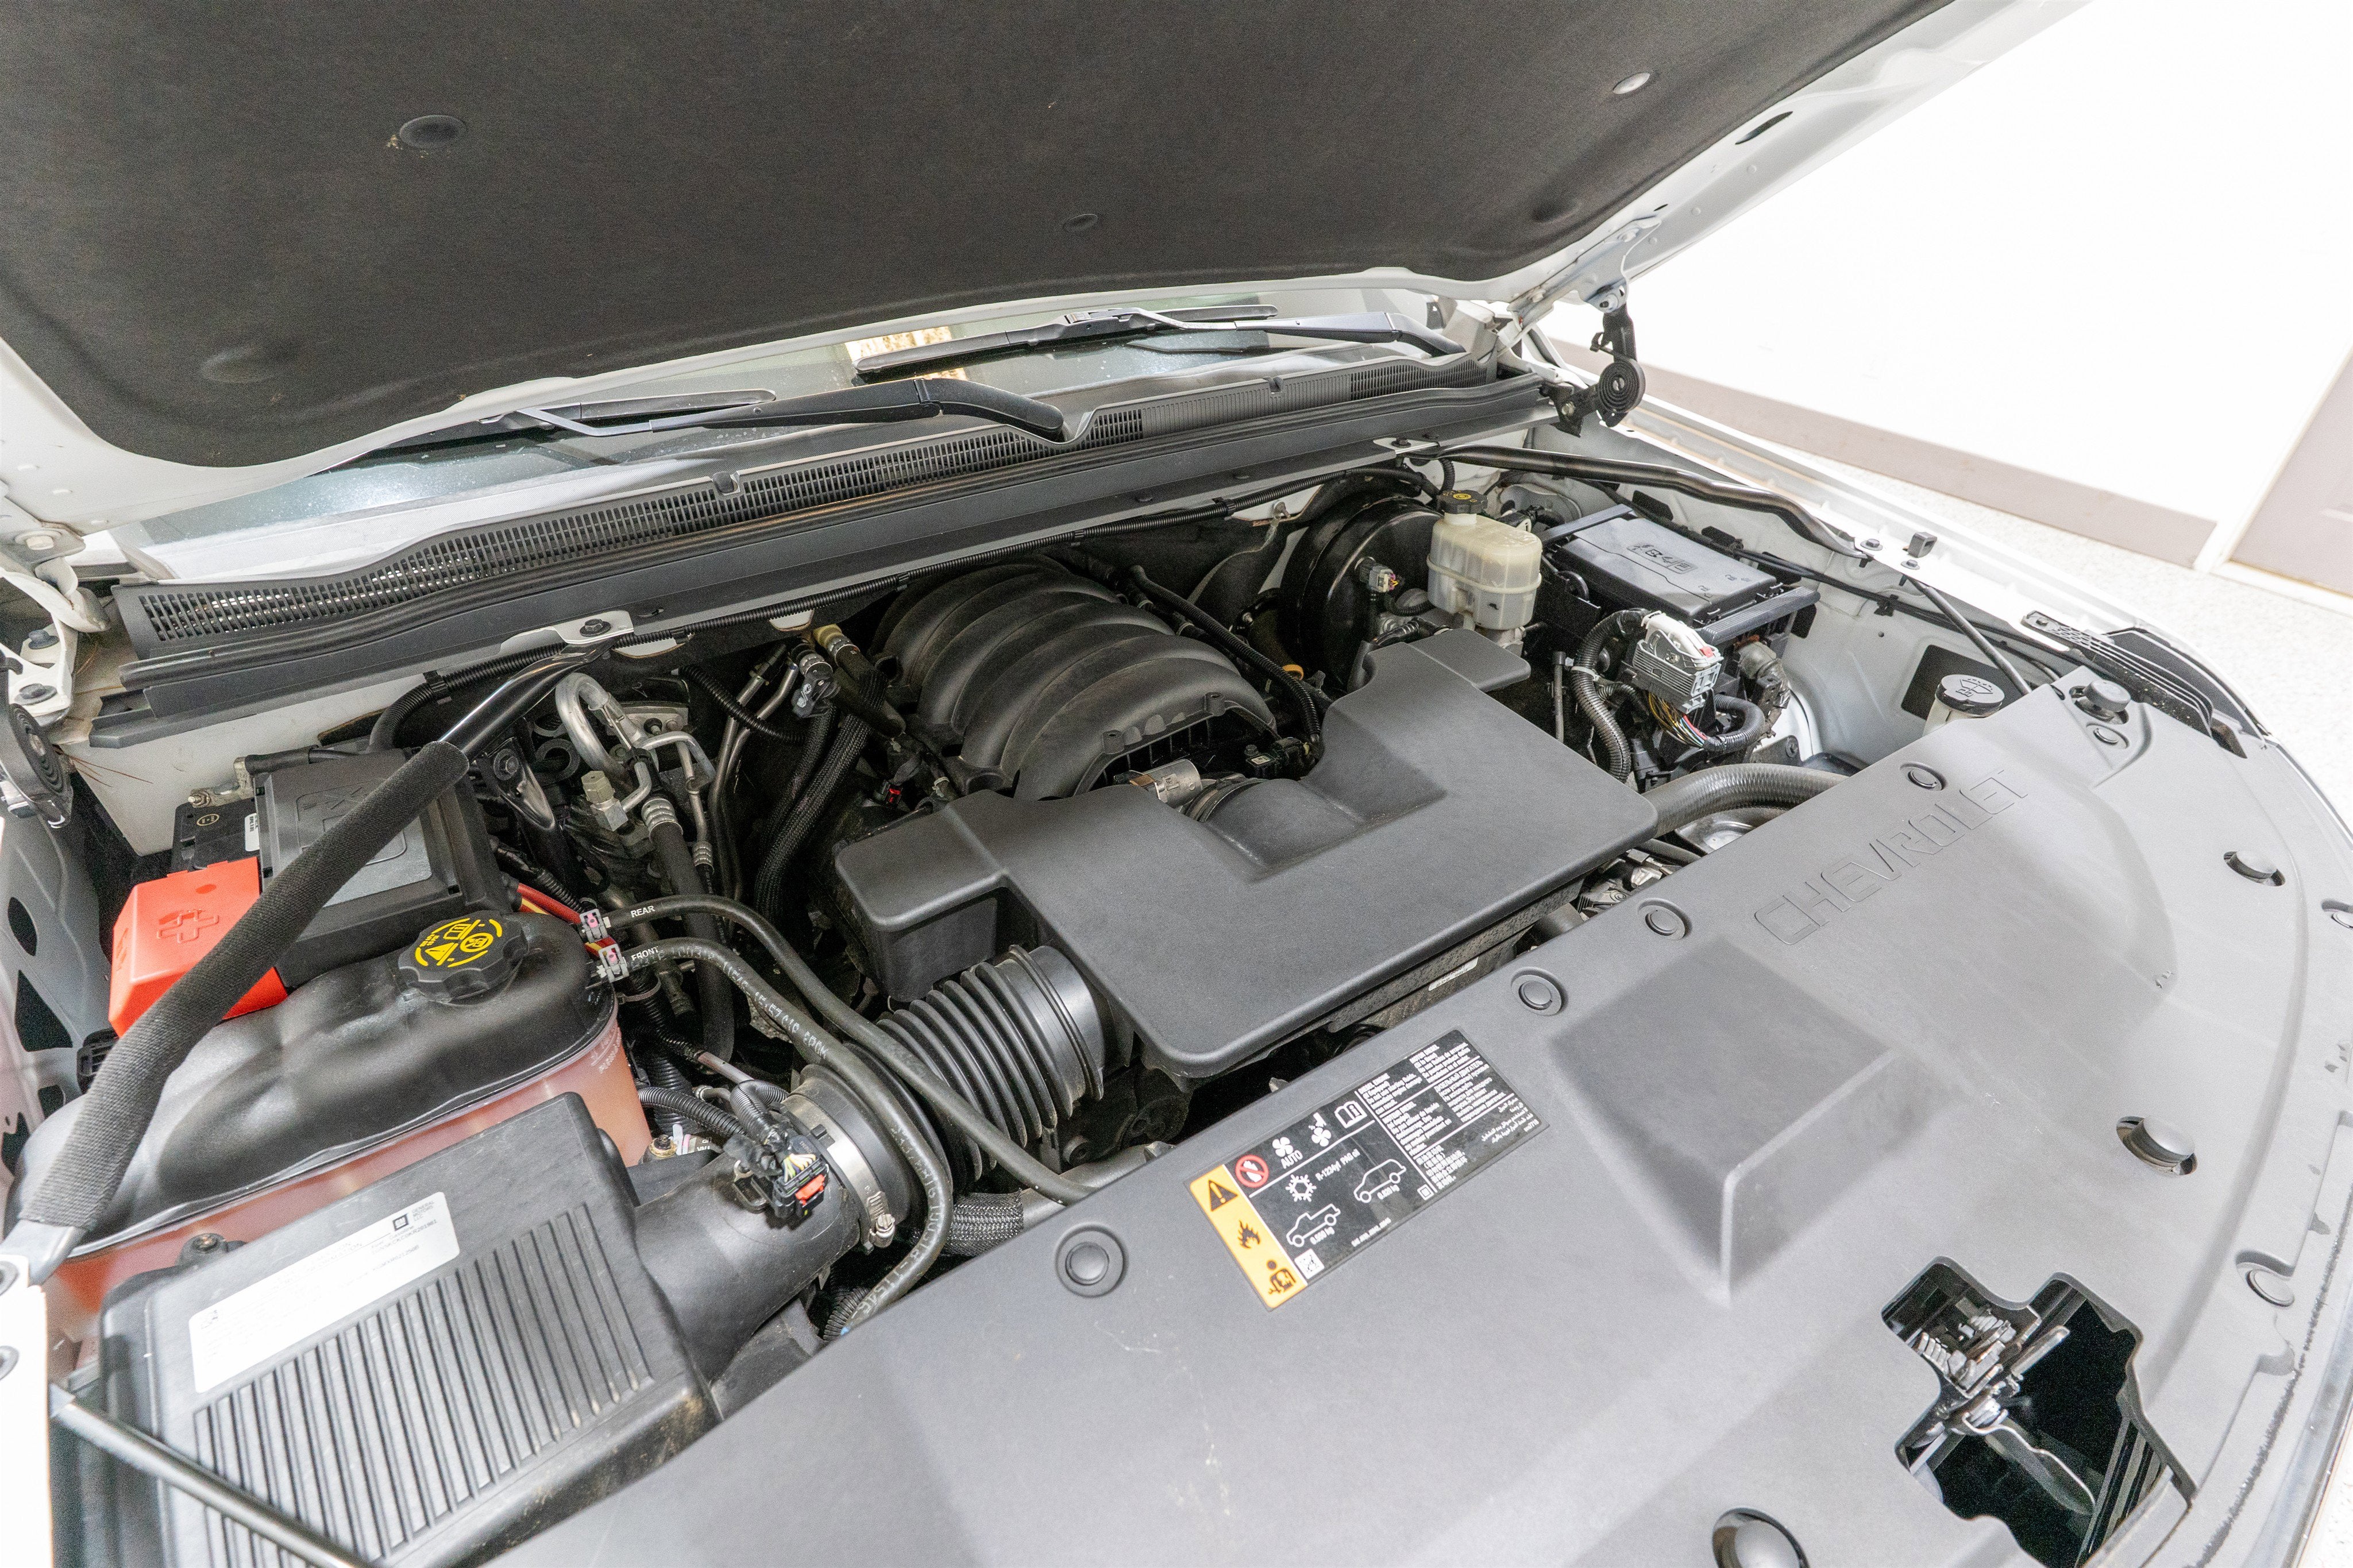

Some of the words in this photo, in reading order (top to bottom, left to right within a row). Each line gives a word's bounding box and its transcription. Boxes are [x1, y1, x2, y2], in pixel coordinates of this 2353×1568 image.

[1754, 770, 2028, 945] CHEVROLET
[630, 905, 655, 918] REAR
[631, 945, 658, 961] FRONT
[1280, 1150, 1303, 1169] AUTO
[1315, 1160, 1341, 1181] R-1234yf
[1340, 1152, 1353, 1165] PAG
